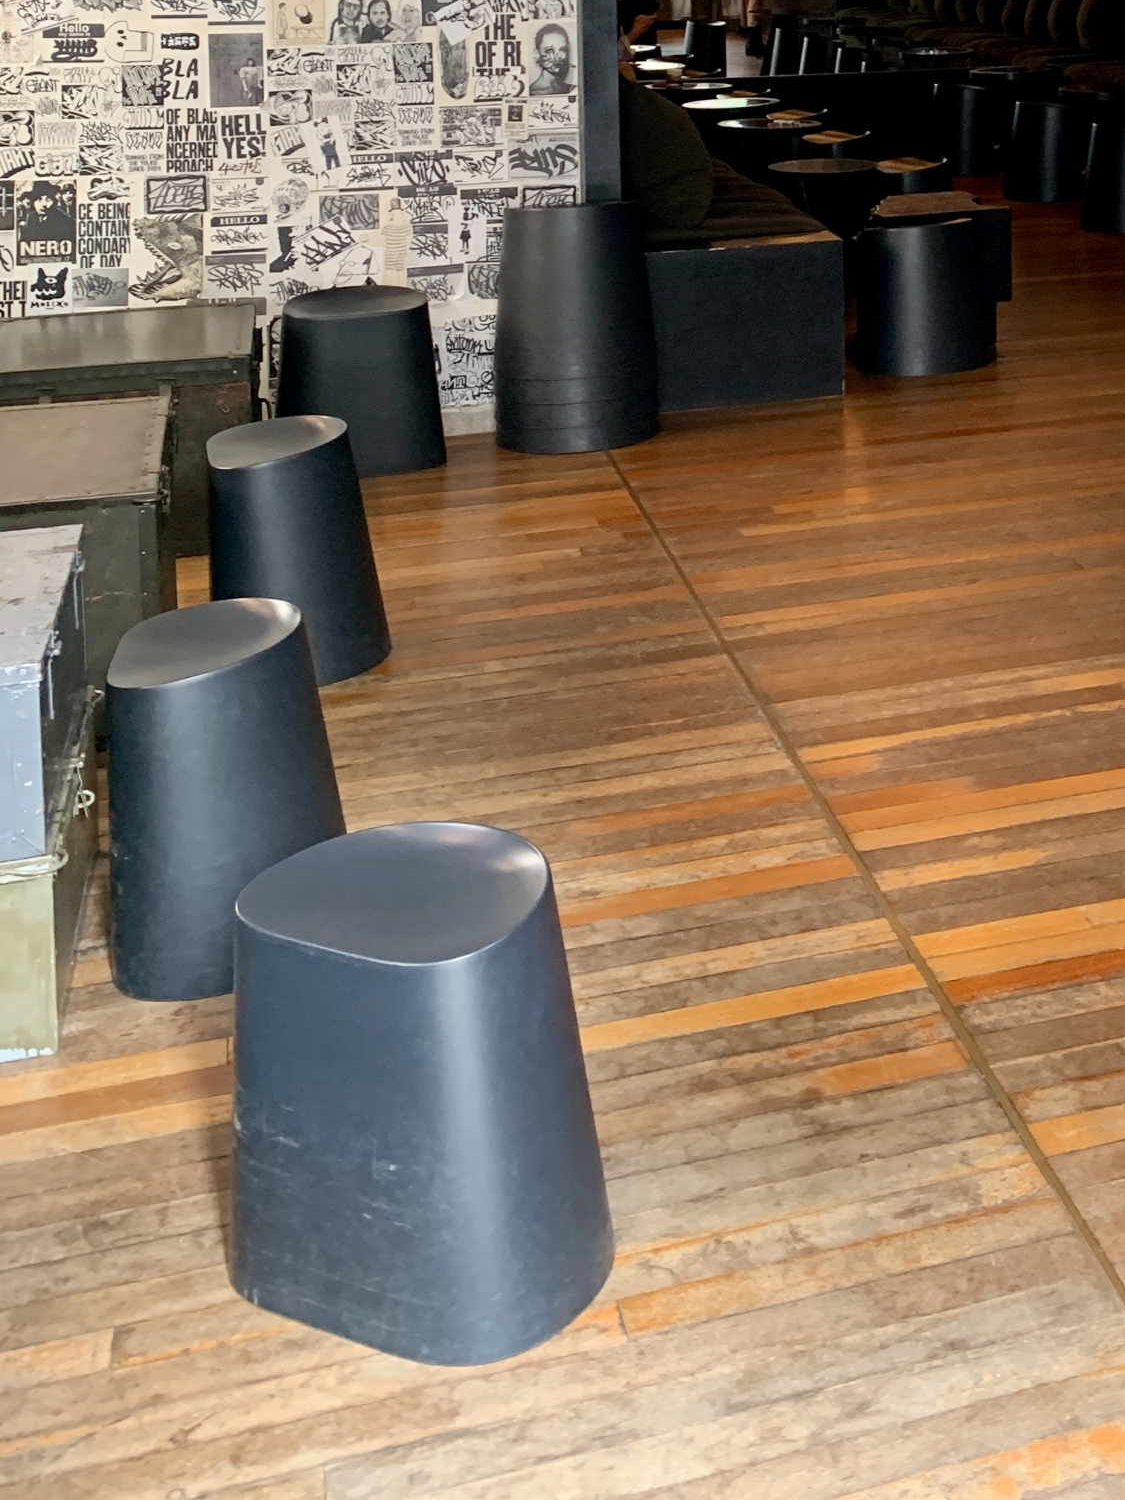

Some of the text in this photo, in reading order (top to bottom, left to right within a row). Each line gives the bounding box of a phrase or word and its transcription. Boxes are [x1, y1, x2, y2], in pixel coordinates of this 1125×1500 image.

[60, 23, 90, 33] Hello
[475, 41, 498, 67] OF
[162, 58, 198, 78] BLA
[166, 108, 181, 125] OF
[221, 113, 267, 137] HELL
[166, 125, 218, 142] ANY MA
[223, 136, 267, 160] YES!
[78, 203, 94, 221] CE
[219, 216, 260, 225] HELLO
[78, 220, 130, 238] CONTAIN
[20, 240, 72, 257] NERO
